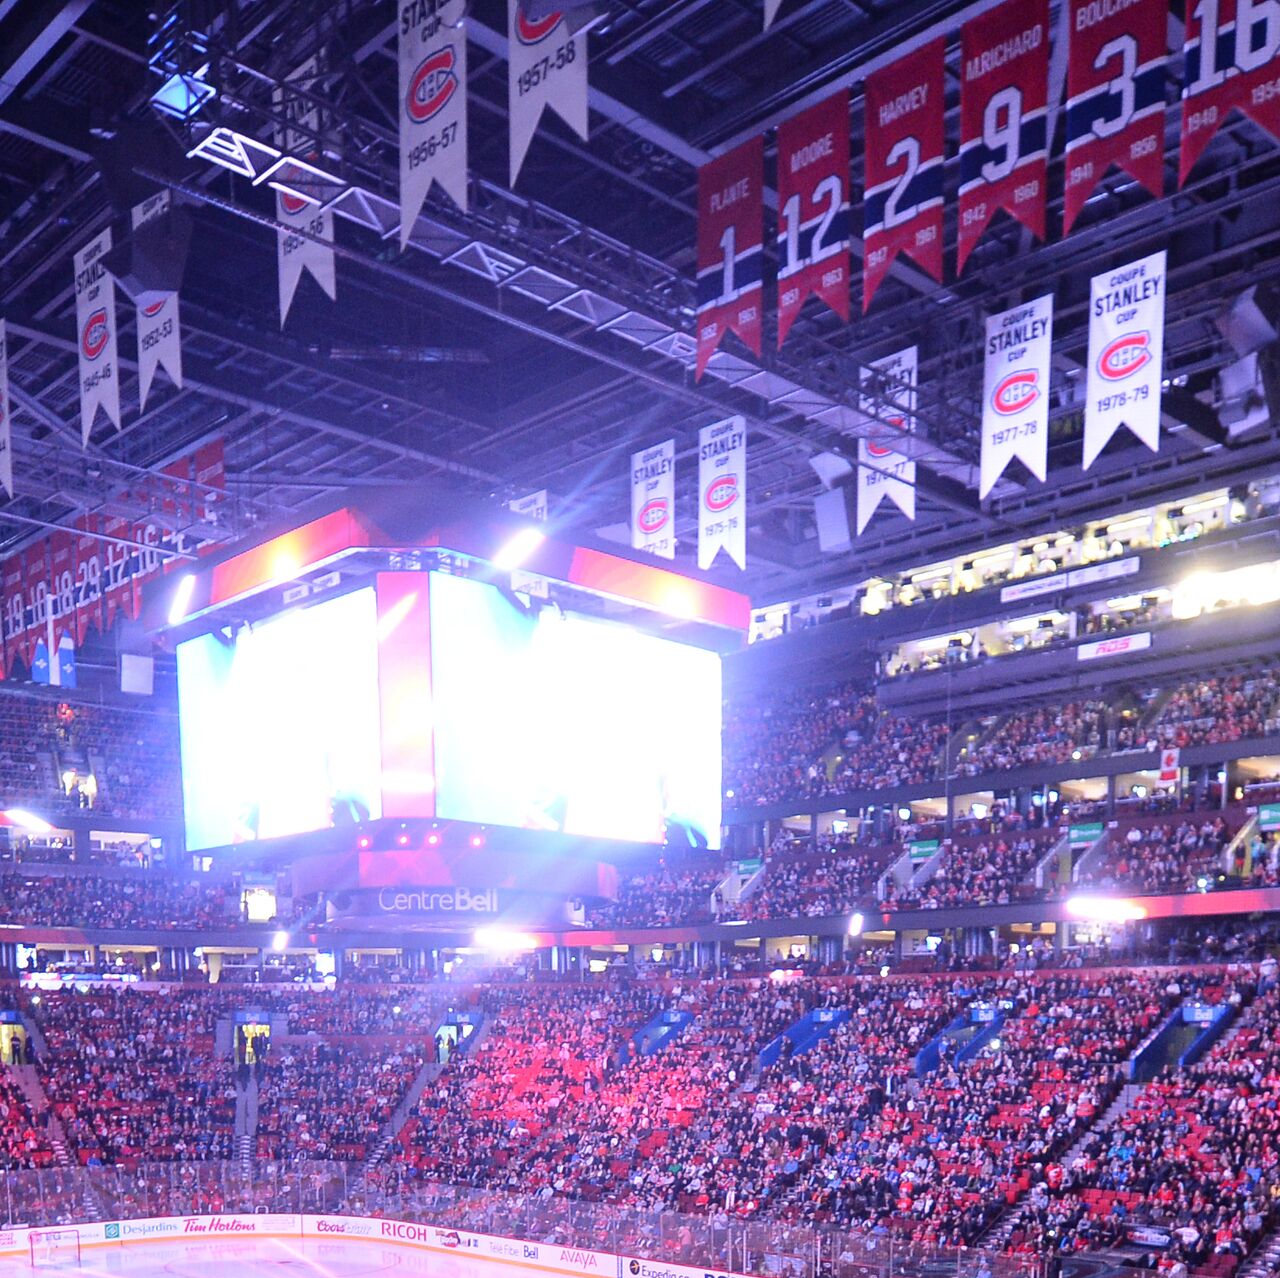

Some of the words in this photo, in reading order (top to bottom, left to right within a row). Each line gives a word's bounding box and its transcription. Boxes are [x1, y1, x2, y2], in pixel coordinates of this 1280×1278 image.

[518, 39, 576, 96] 1957-58
[1092, 34, 1138, 138] 3
[880, 84, 928, 127] HARVEY
[1188, 105, 1218, 132] 1940
[407, 121, 458, 170] 1956-57
[982, 86, 1022, 183] 9
[791, 133, 833, 173] MOORE
[711, 178, 750, 213] PLANTE
[884, 137, 920, 229] 2
[782, 175, 842, 277] 12
[720, 225, 740, 307] 1
[1110, 265, 1147, 288] COUPE
[1095, 275, 1162, 317] STANLEY
[1002, 306, 1035, 328] COUPE
[1116, 308, 1138, 325] CUP
[989, 317, 1049, 355] STANLEY
[1007, 349, 1028, 363] CUP
[1097, 384, 1149, 412] 1978-79
[701, 432, 744, 461] STANLEY
[992, 421, 1038, 446] 1977-78
[634, 458, 673, 485] STANLEY
[122, 1223, 178, 1236] Desjardins
[183, 1218, 207, 1233] Tim
[208, 1217, 256, 1233] Hortons
[316, 1220, 346, 1234] Coors
[381, 1222, 427, 1242] RICOH
[523, 1245, 539, 1260] Bell
[560, 1249, 597, 1269] AVAYA
